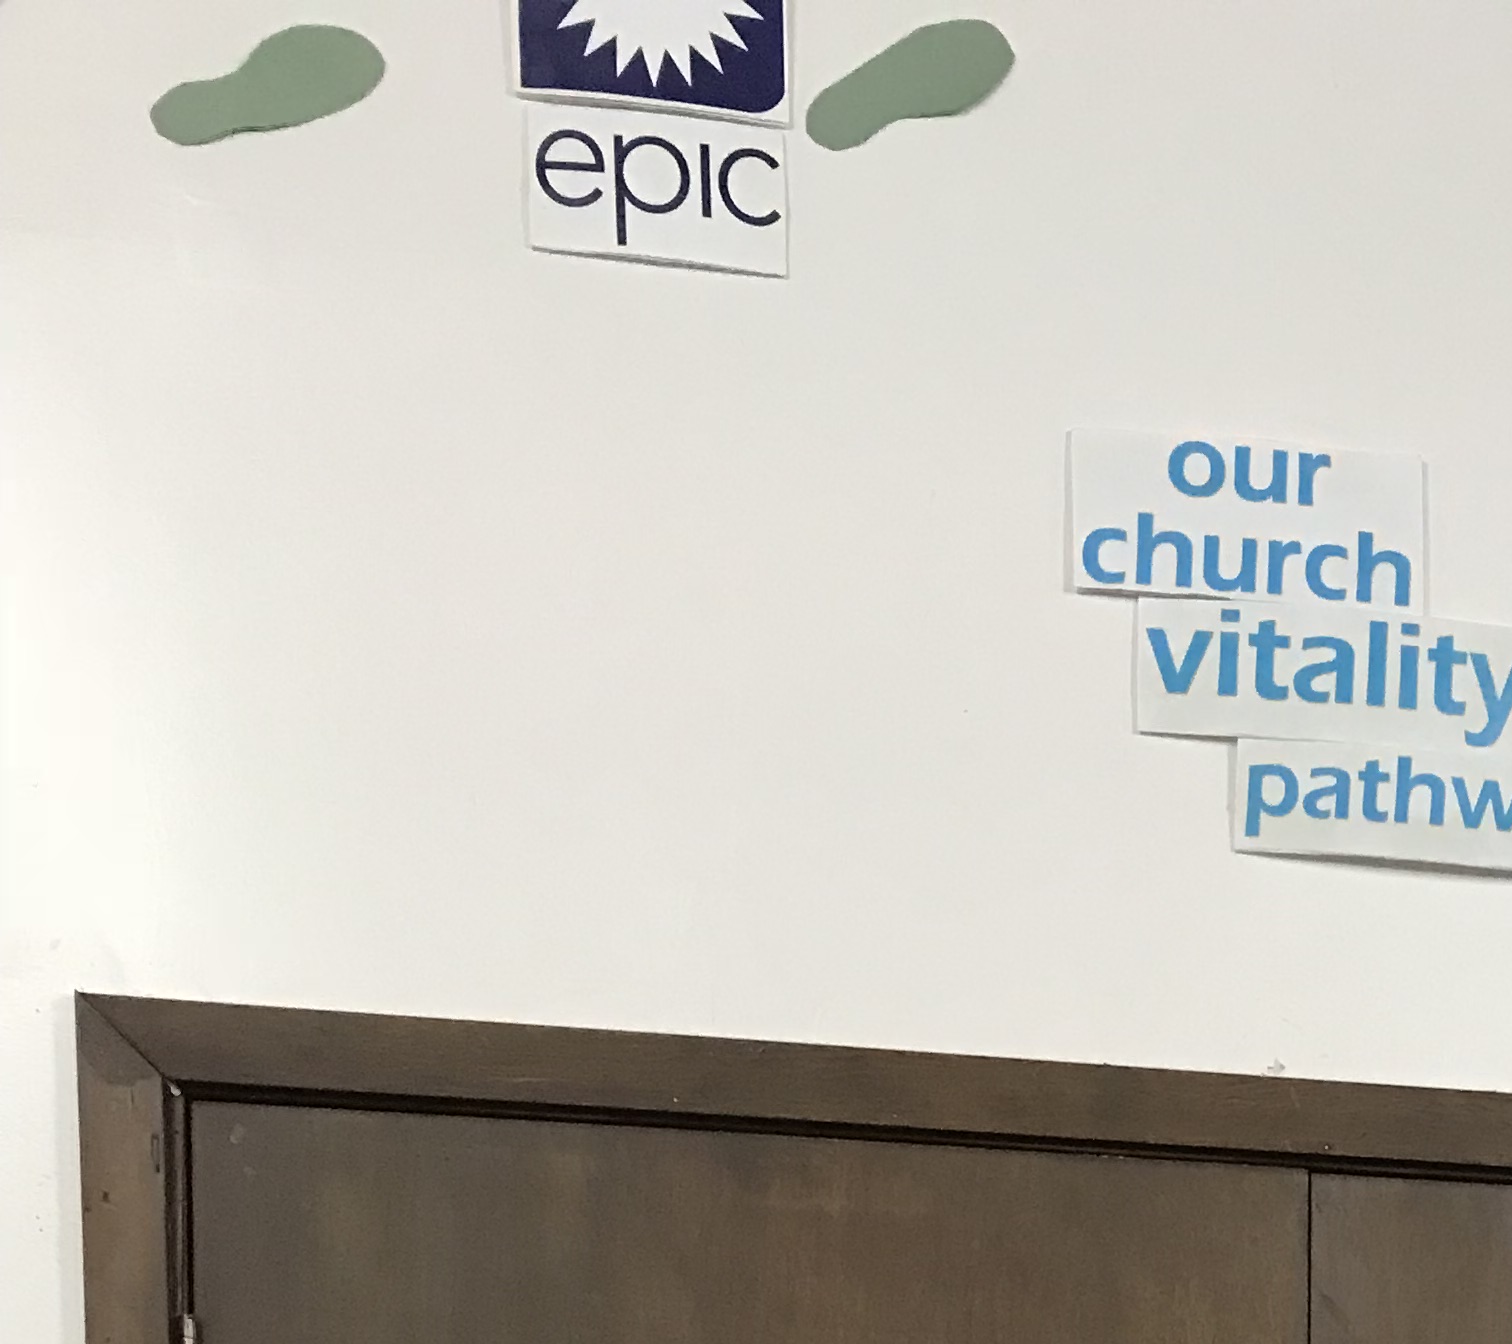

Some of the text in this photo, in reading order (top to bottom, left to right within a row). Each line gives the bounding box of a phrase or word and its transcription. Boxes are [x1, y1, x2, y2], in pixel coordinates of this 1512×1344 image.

[536, 129, 781, 246] epic
[1167, 440, 1332, 507] our
[1081, 512, 1412, 607] church
